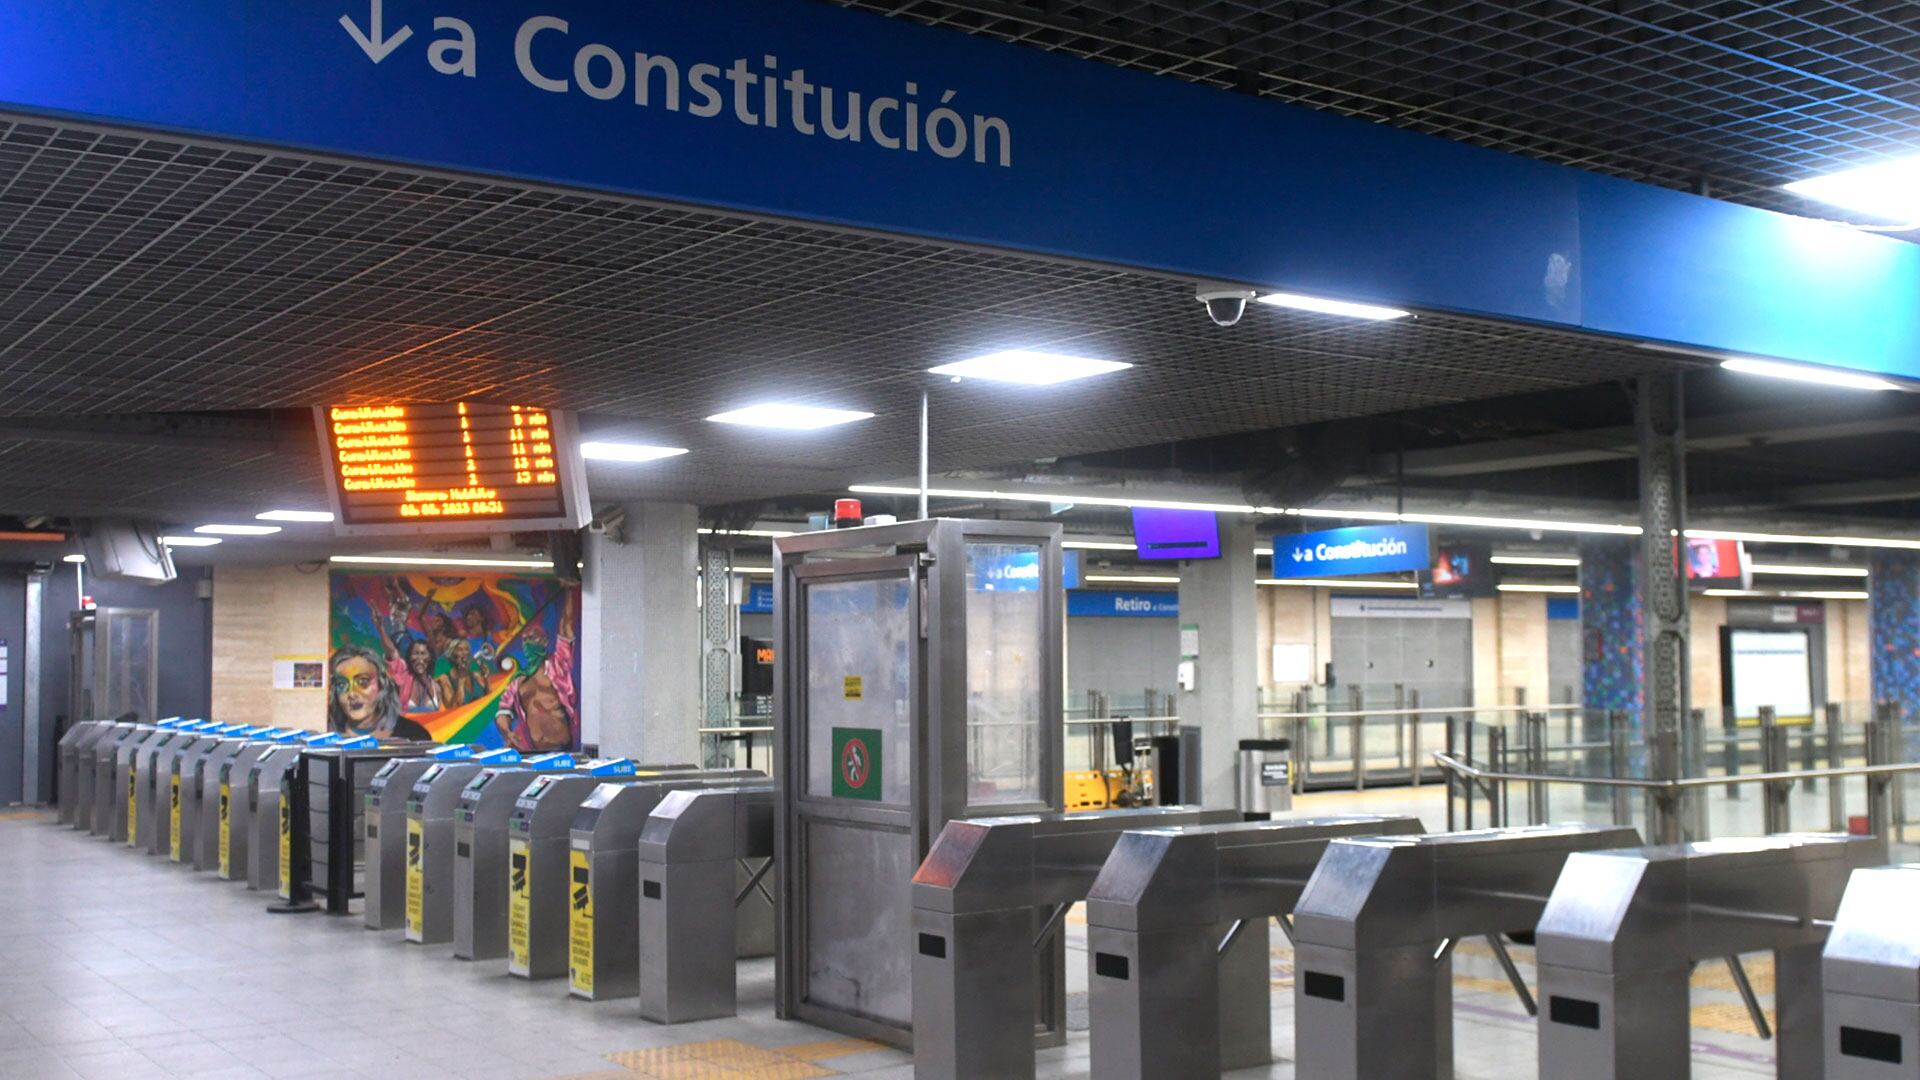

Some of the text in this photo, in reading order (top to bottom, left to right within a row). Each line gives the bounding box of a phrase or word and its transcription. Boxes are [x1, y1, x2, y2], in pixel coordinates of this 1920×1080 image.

[426, 16, 1012, 168] a Constitución
[1304, 537, 1407, 562] a Constitución
[1115, 597, 1151, 612] Retiro
[554, 759, 571, 767] SUBE
[613, 765, 631, 773] SUBE
